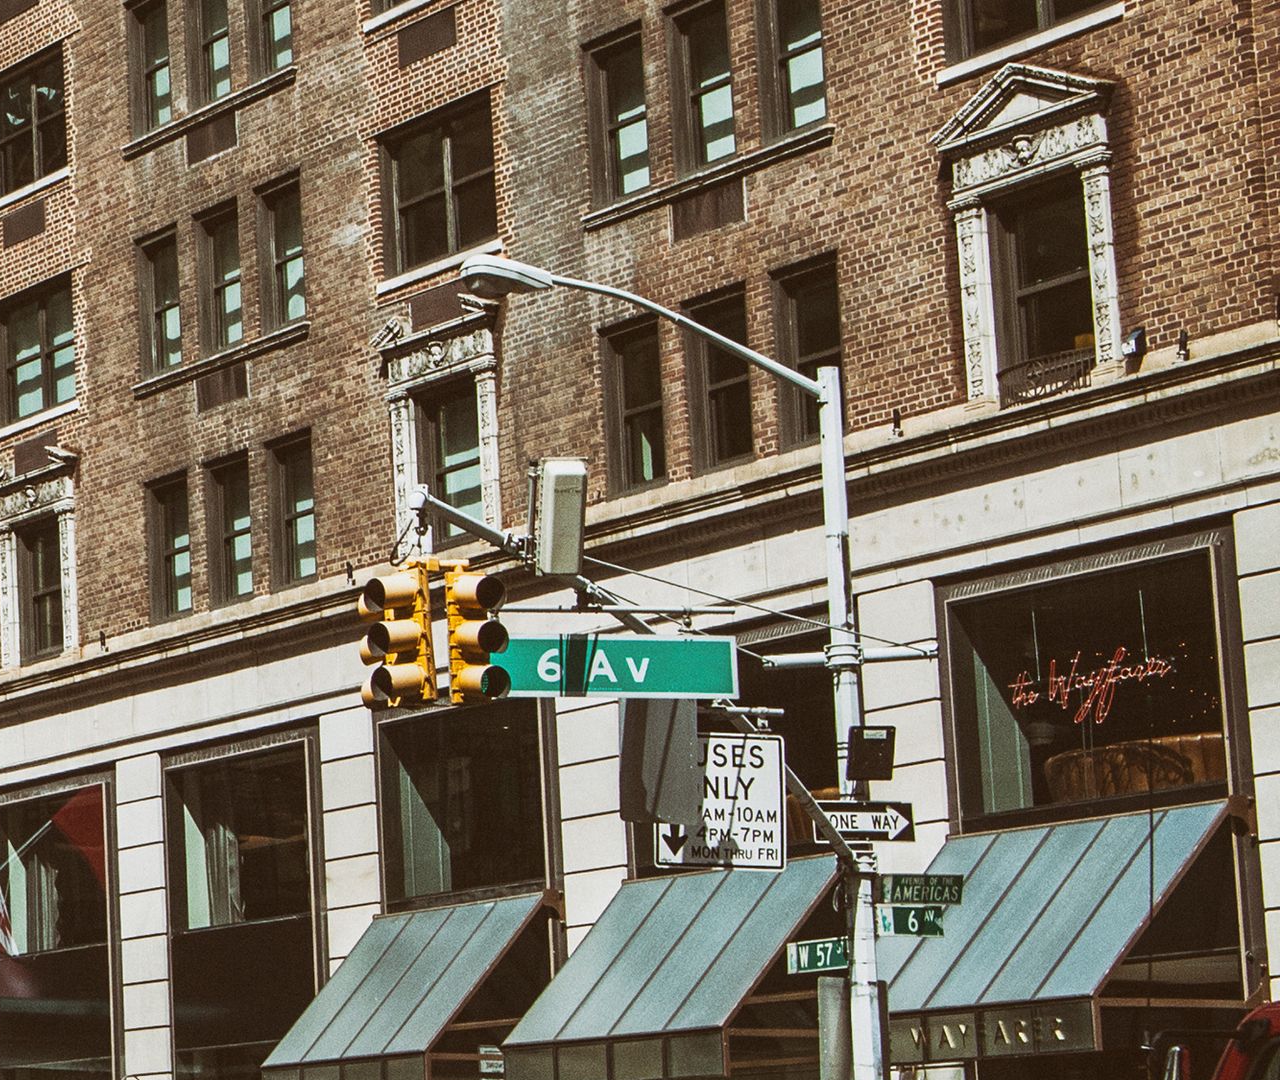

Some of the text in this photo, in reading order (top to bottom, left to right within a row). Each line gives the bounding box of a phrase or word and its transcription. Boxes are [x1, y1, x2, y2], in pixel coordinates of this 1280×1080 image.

[537, 648, 650, 682] 6 Av
[1008, 647, 1171, 724] the Wayfarer
[702, 776, 755, 800] NLY
[699, 806, 777, 823] AM-10AM
[829, 814, 899, 830] ONE WAY
[696, 827, 774, 843] 4PM-7PM
[692, 846, 778, 860] MON THRU FRI
[930, 877, 937, 885] OF
[894, 886, 959, 901] AMERICAS
[908, 910, 935, 932] 6 AV
[799, 945, 809, 968] W
[817, 943, 833, 967] 57
